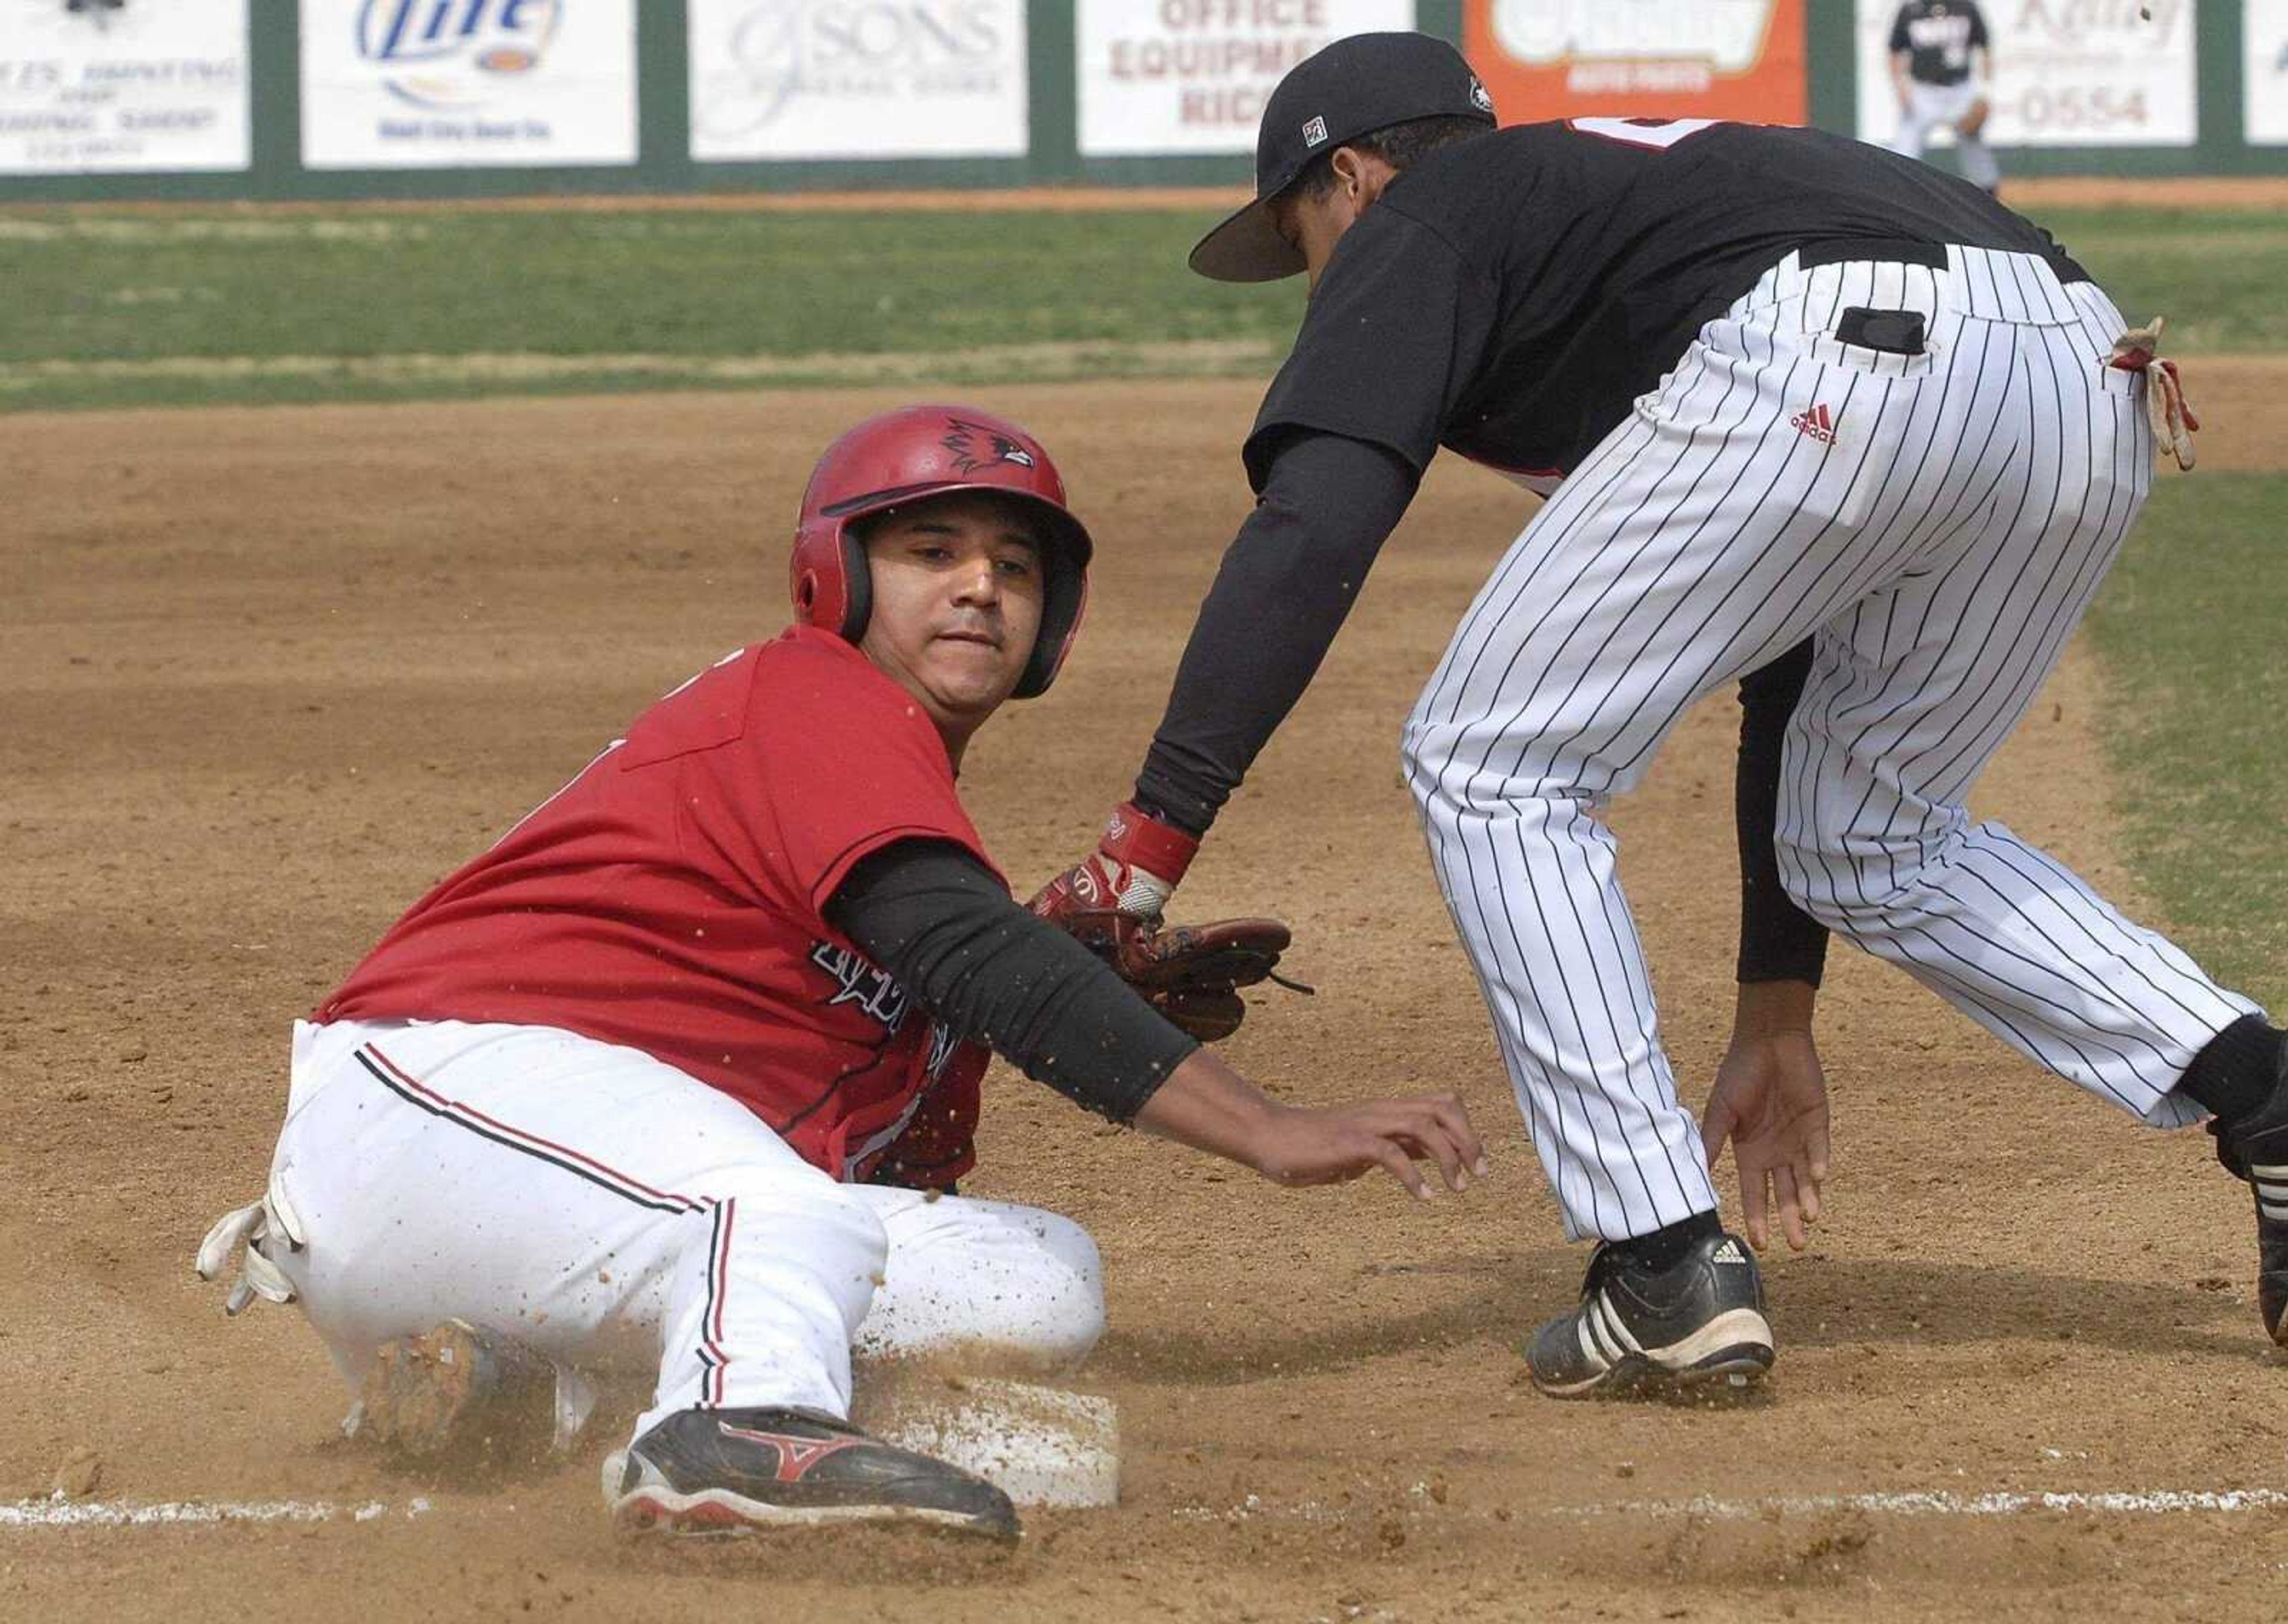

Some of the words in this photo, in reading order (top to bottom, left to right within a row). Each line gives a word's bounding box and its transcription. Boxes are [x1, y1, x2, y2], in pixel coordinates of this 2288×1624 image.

[1161, 0, 1327, 28] OFFICE
[1182, 86, 1269, 124] RIC
[1790, 416, 1836, 446] adidas
